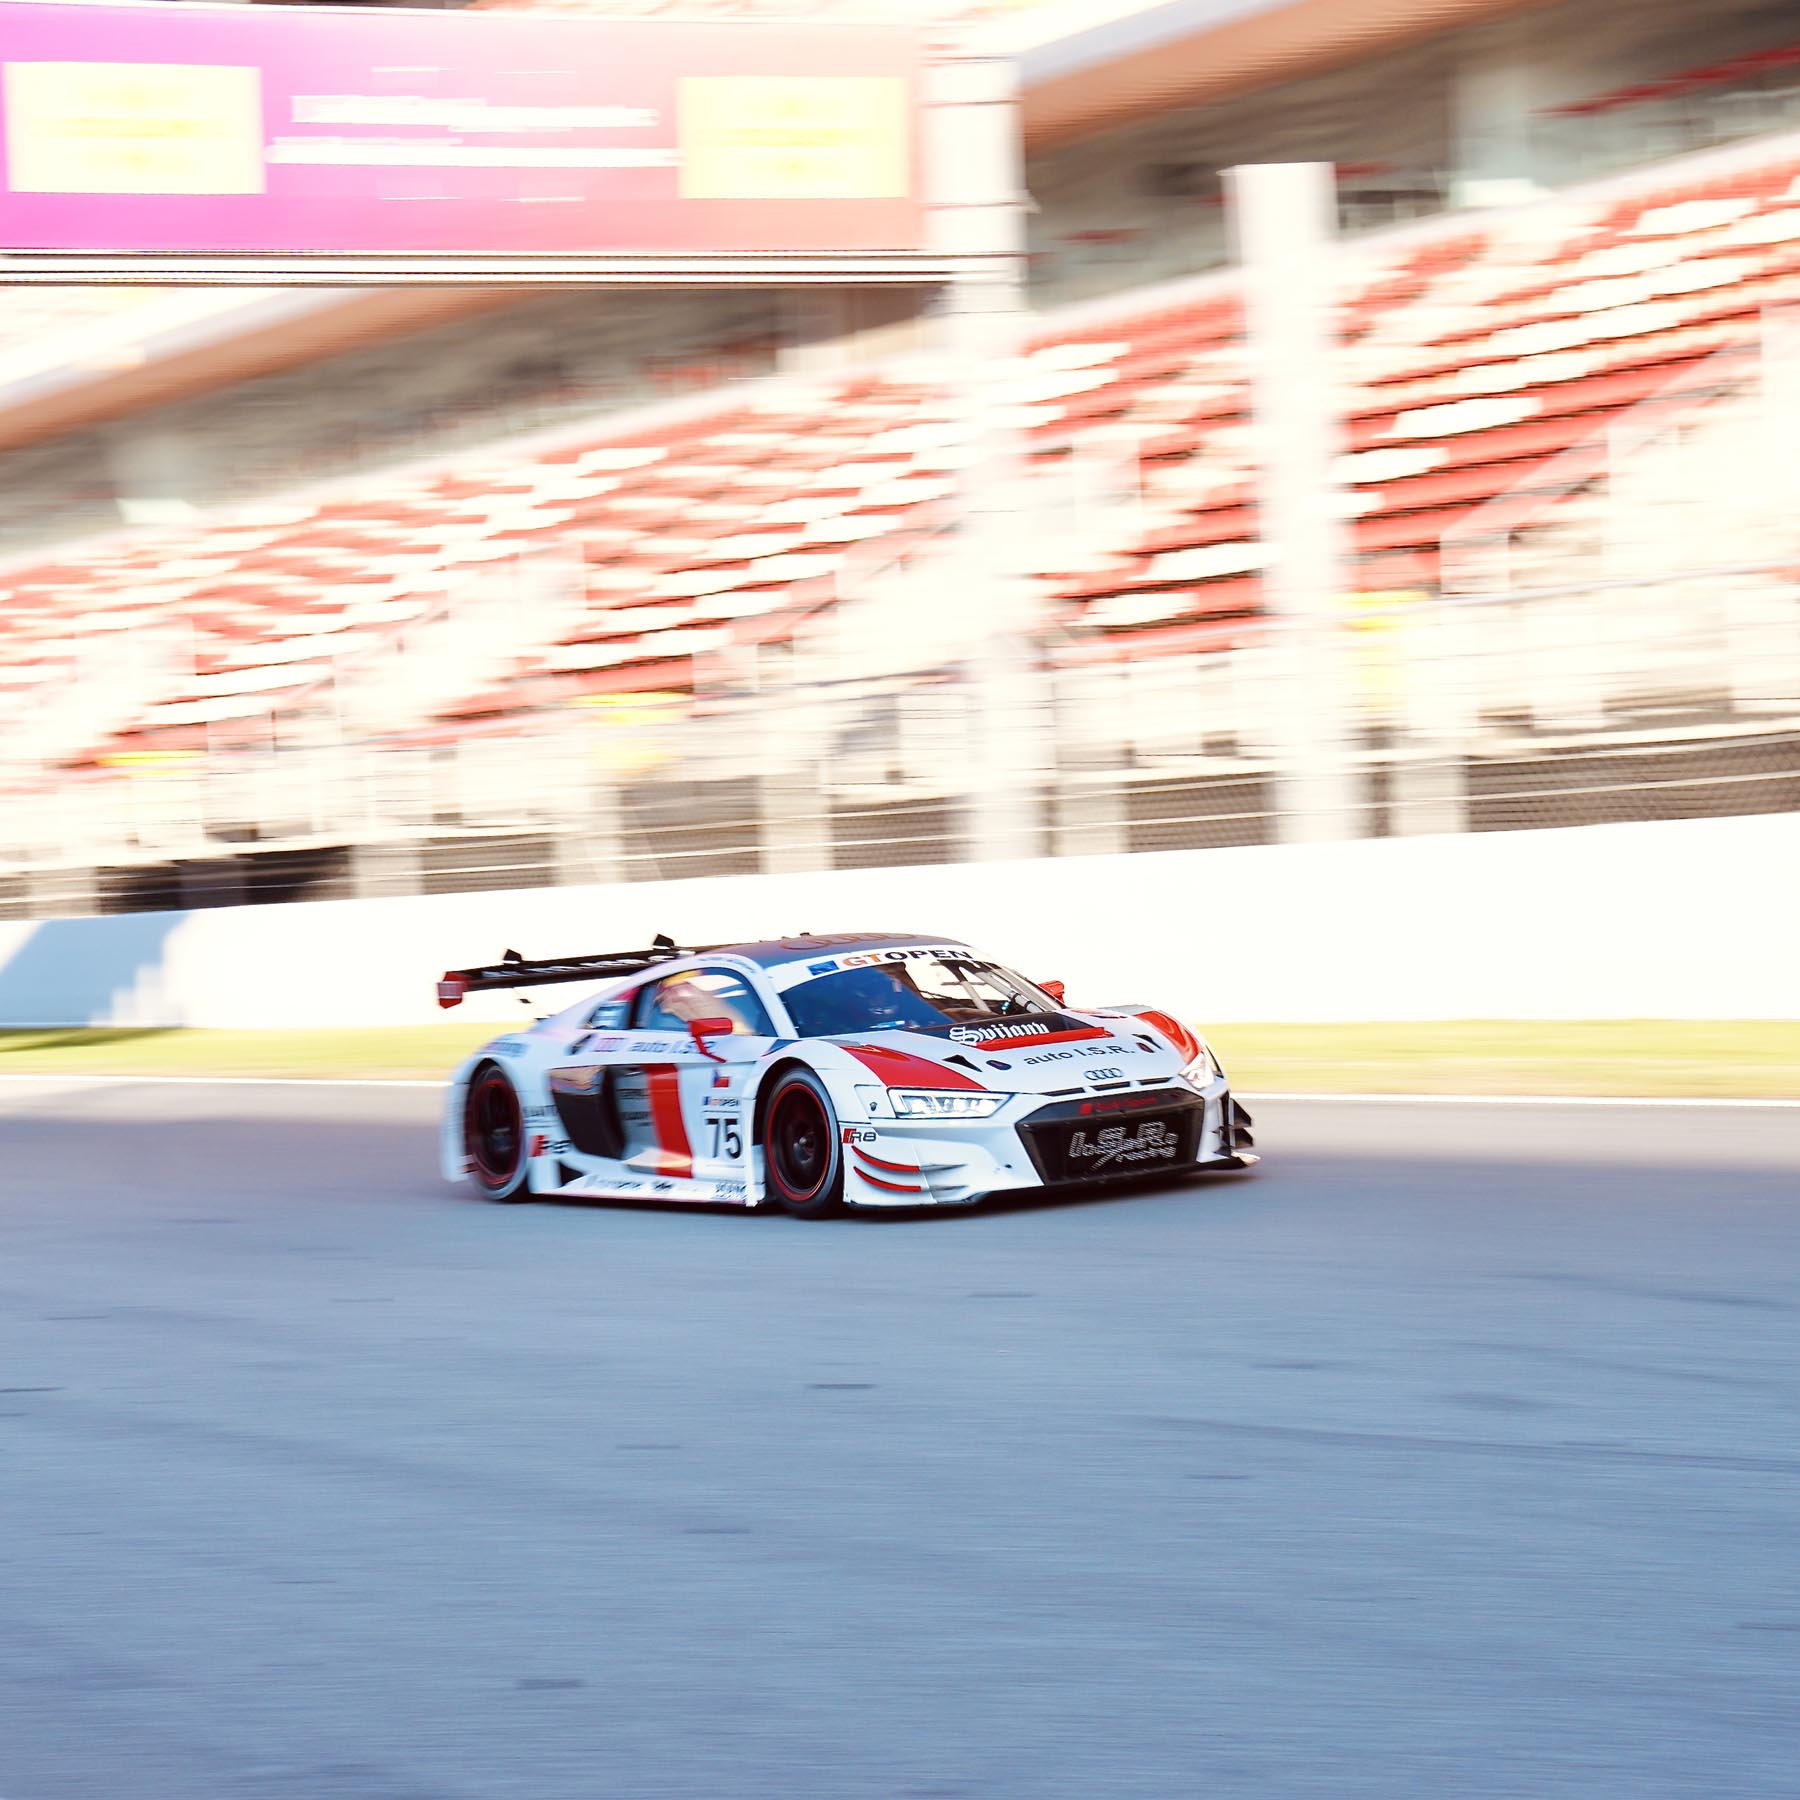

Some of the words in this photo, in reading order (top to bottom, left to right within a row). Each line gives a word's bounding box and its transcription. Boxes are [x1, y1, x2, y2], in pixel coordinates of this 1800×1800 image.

[1023, 1052, 1073, 1065] auto
[1073, 1045, 1136, 1057] I.S.R.
[704, 1118, 742, 1160] 75
[850, 1131, 877, 1143] R8
